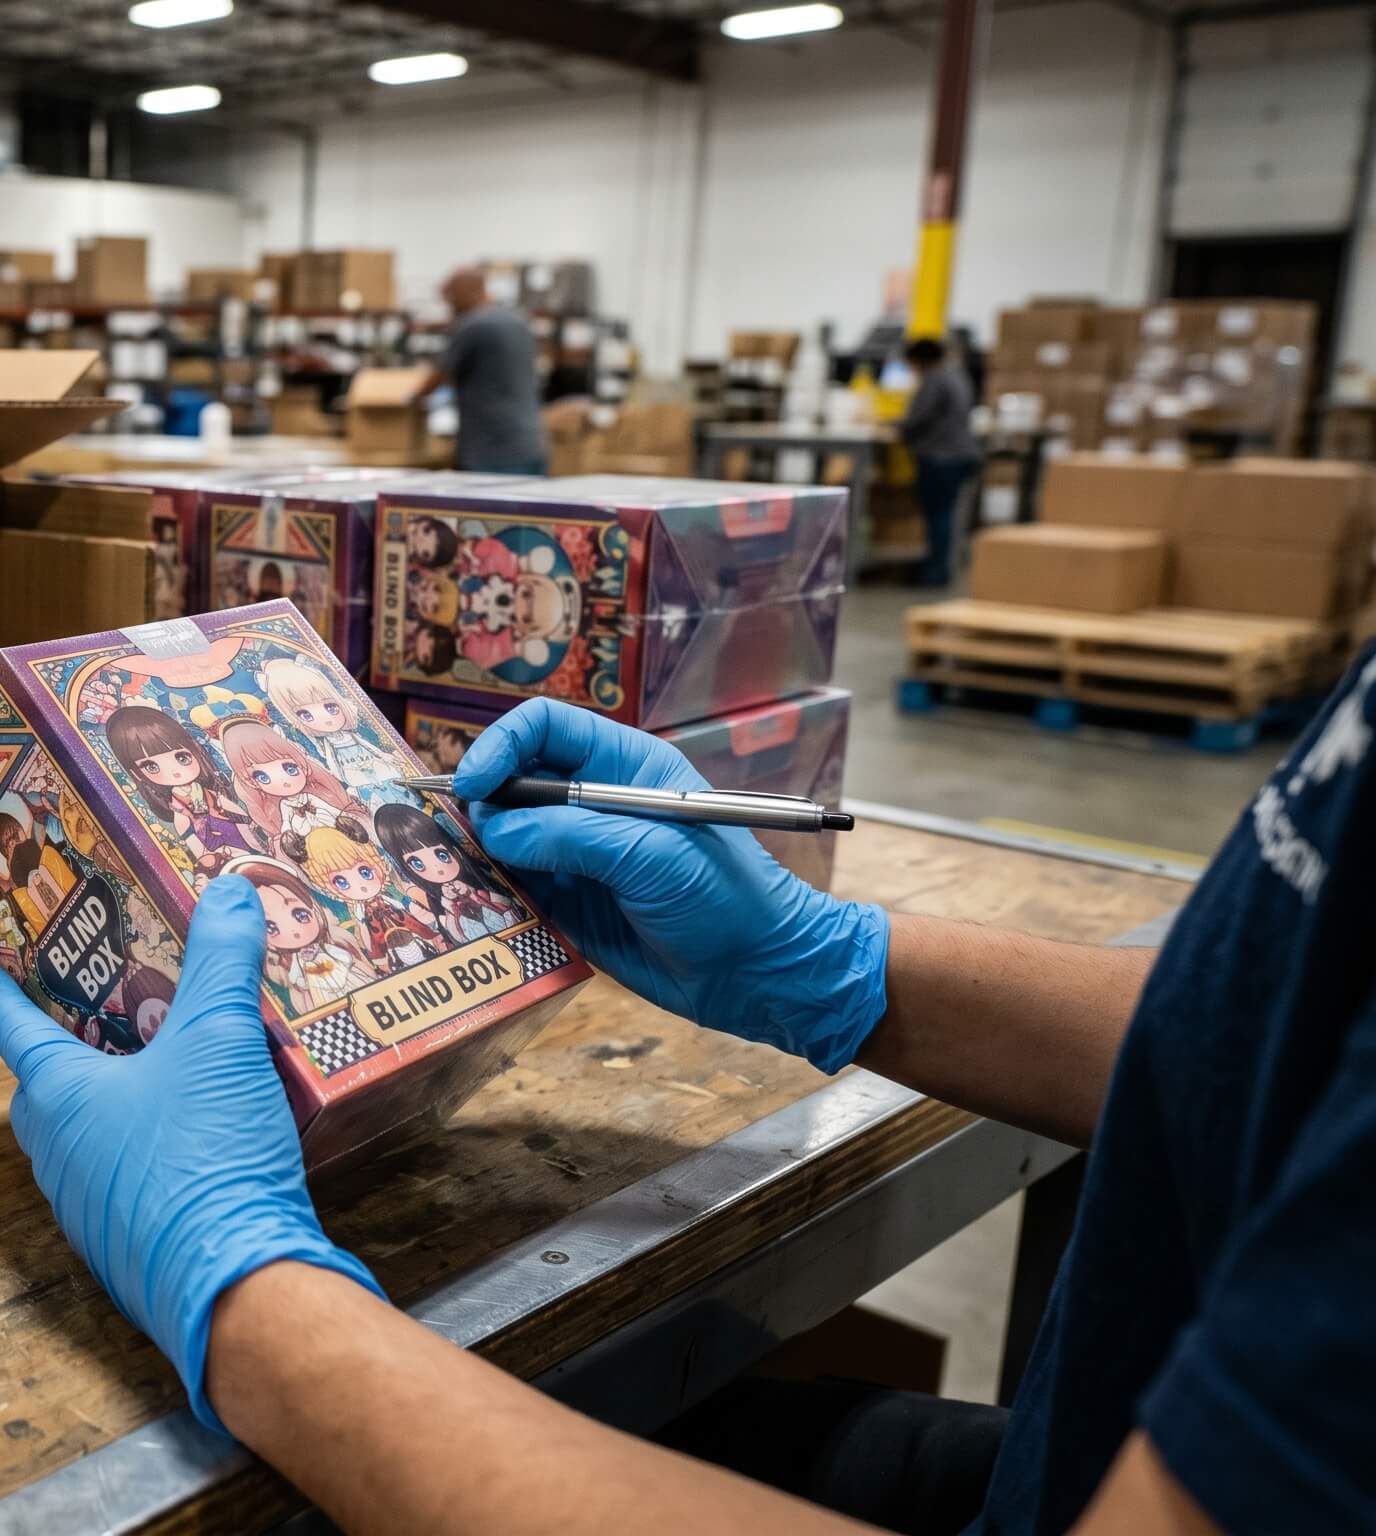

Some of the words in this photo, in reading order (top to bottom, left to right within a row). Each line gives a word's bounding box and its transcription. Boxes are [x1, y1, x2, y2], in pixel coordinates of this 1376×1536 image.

[385, 553, 400, 609] BLIND
[384, 617, 398, 650] BOX
[47, 895, 107, 979] BLIND
[75, 936, 124, 1002] BOX
[366, 975, 453, 1031] BLIND
[448, 950, 511, 994] BOX
